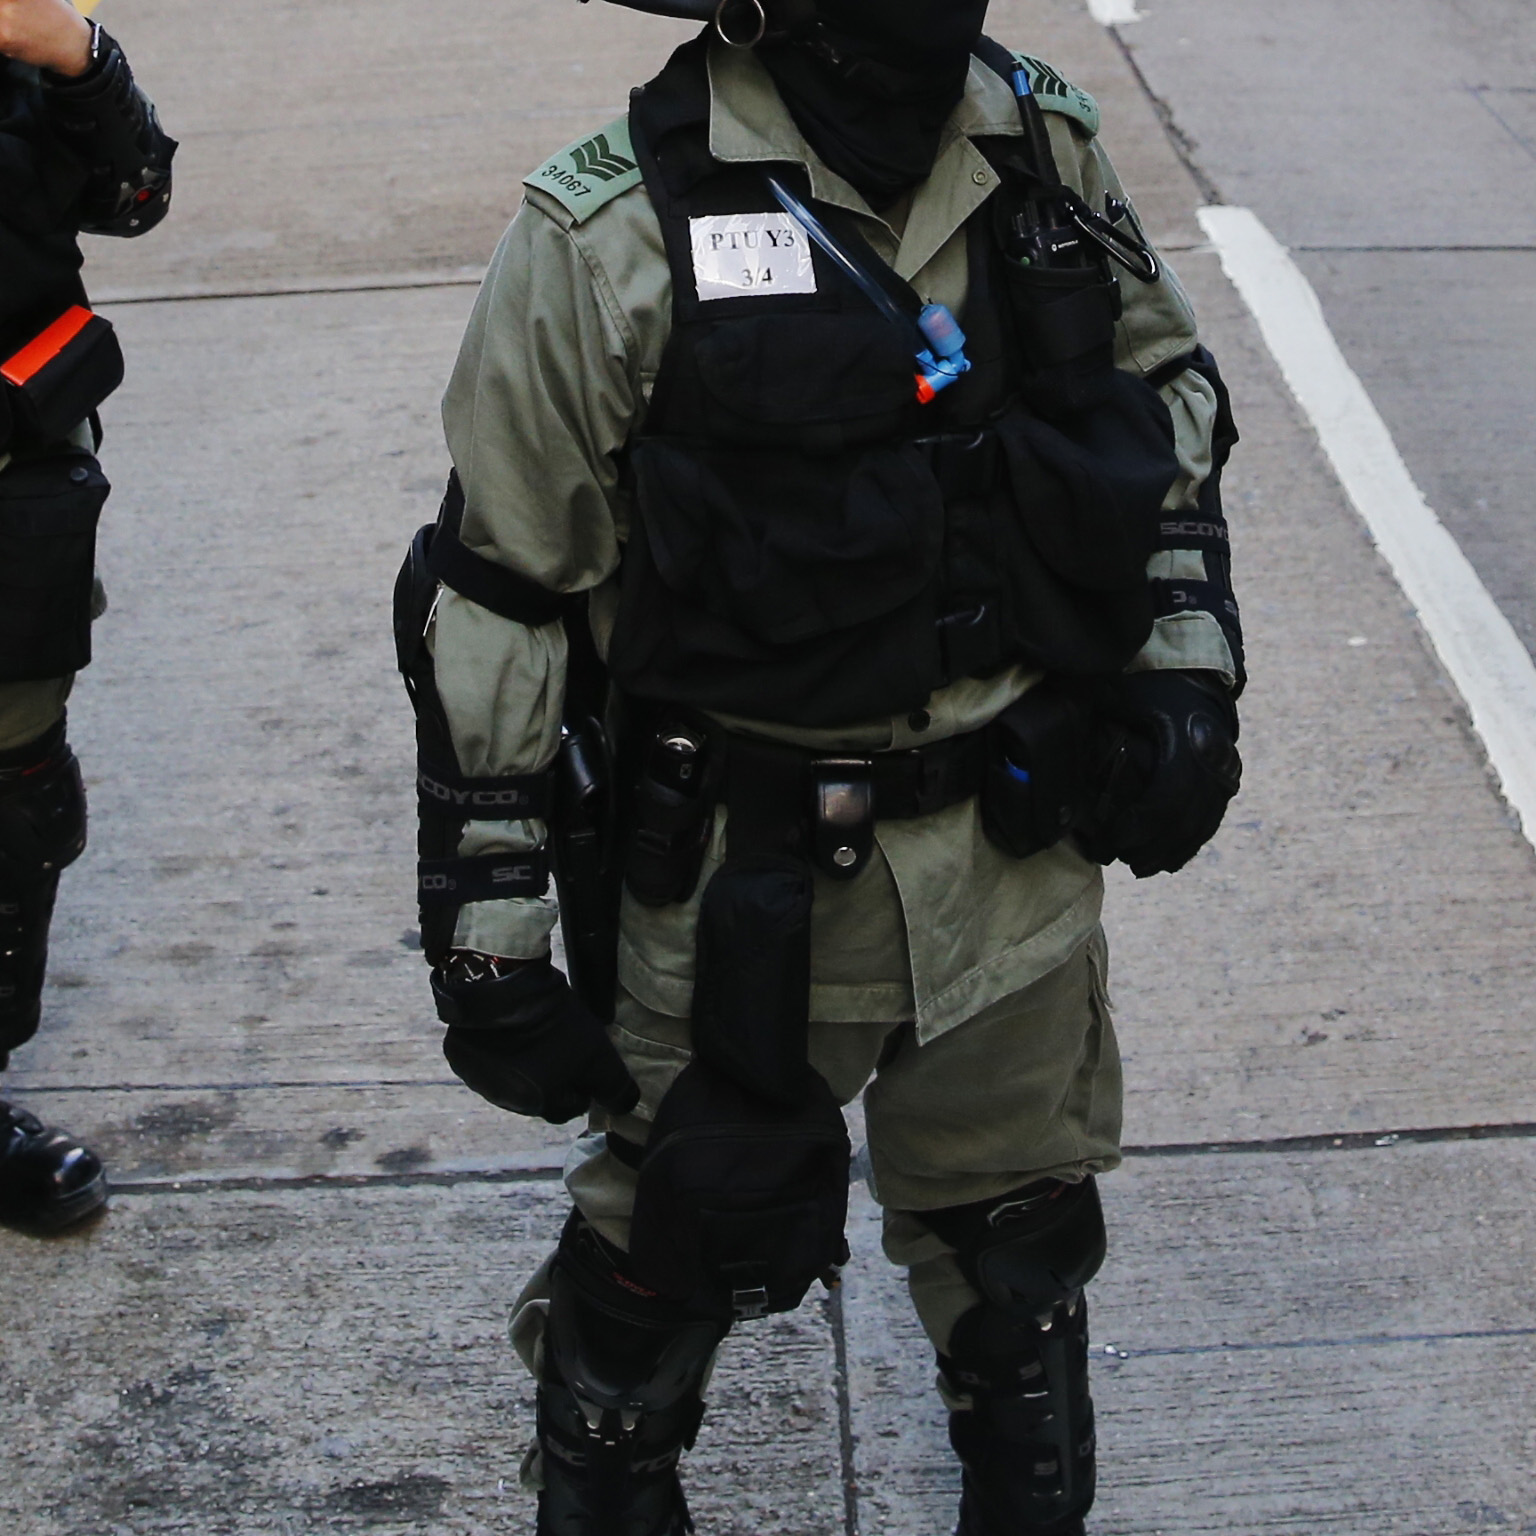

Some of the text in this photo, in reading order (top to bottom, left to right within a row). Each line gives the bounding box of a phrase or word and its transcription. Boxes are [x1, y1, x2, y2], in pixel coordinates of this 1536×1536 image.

[541, 164, 592, 197] 34067
[709, 228, 795, 251] PTU Y3
[740, 267, 774, 287] 3/4
[421, 775, 519, 805] COYCO
